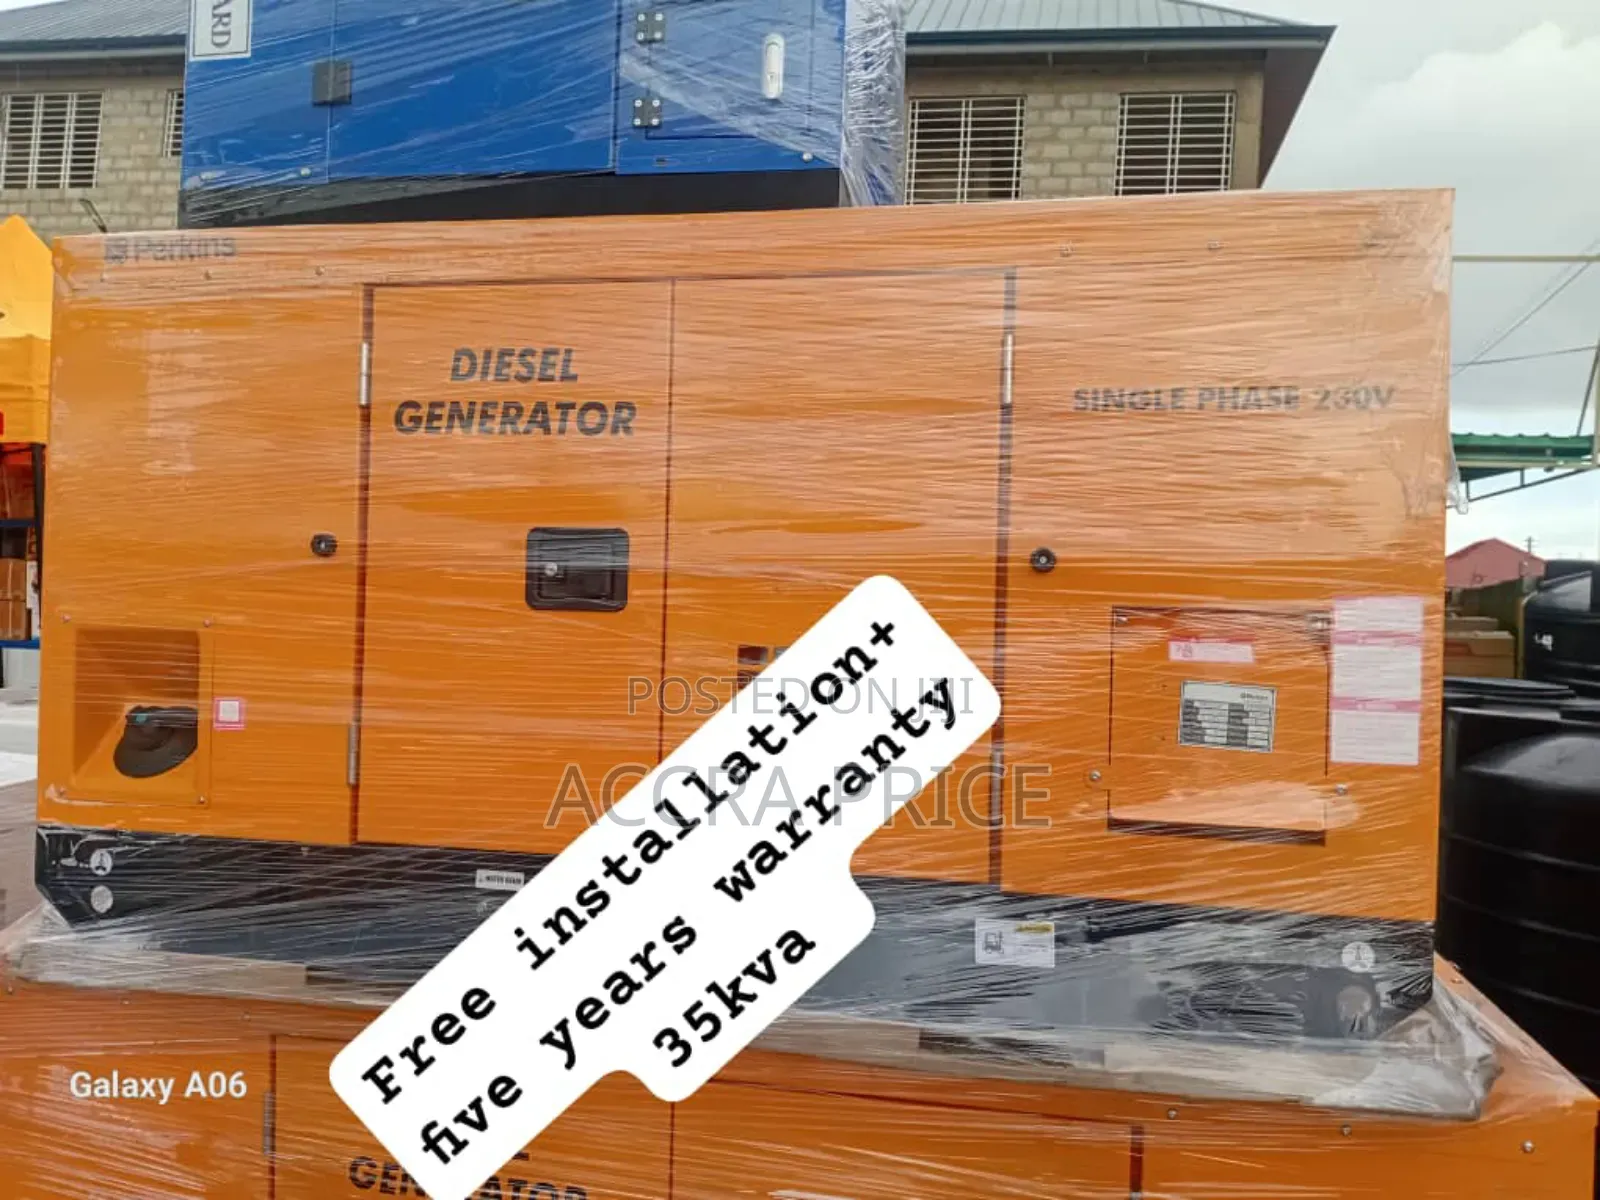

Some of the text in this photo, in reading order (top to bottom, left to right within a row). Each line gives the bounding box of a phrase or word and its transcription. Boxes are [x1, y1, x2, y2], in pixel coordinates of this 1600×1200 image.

[450, 347, 579, 383] DIESEL
[1073, 387, 1185, 412] SINGLE
[1197, 386, 1300, 411] PHASE
[394, 401, 637, 436] GENERATOR
